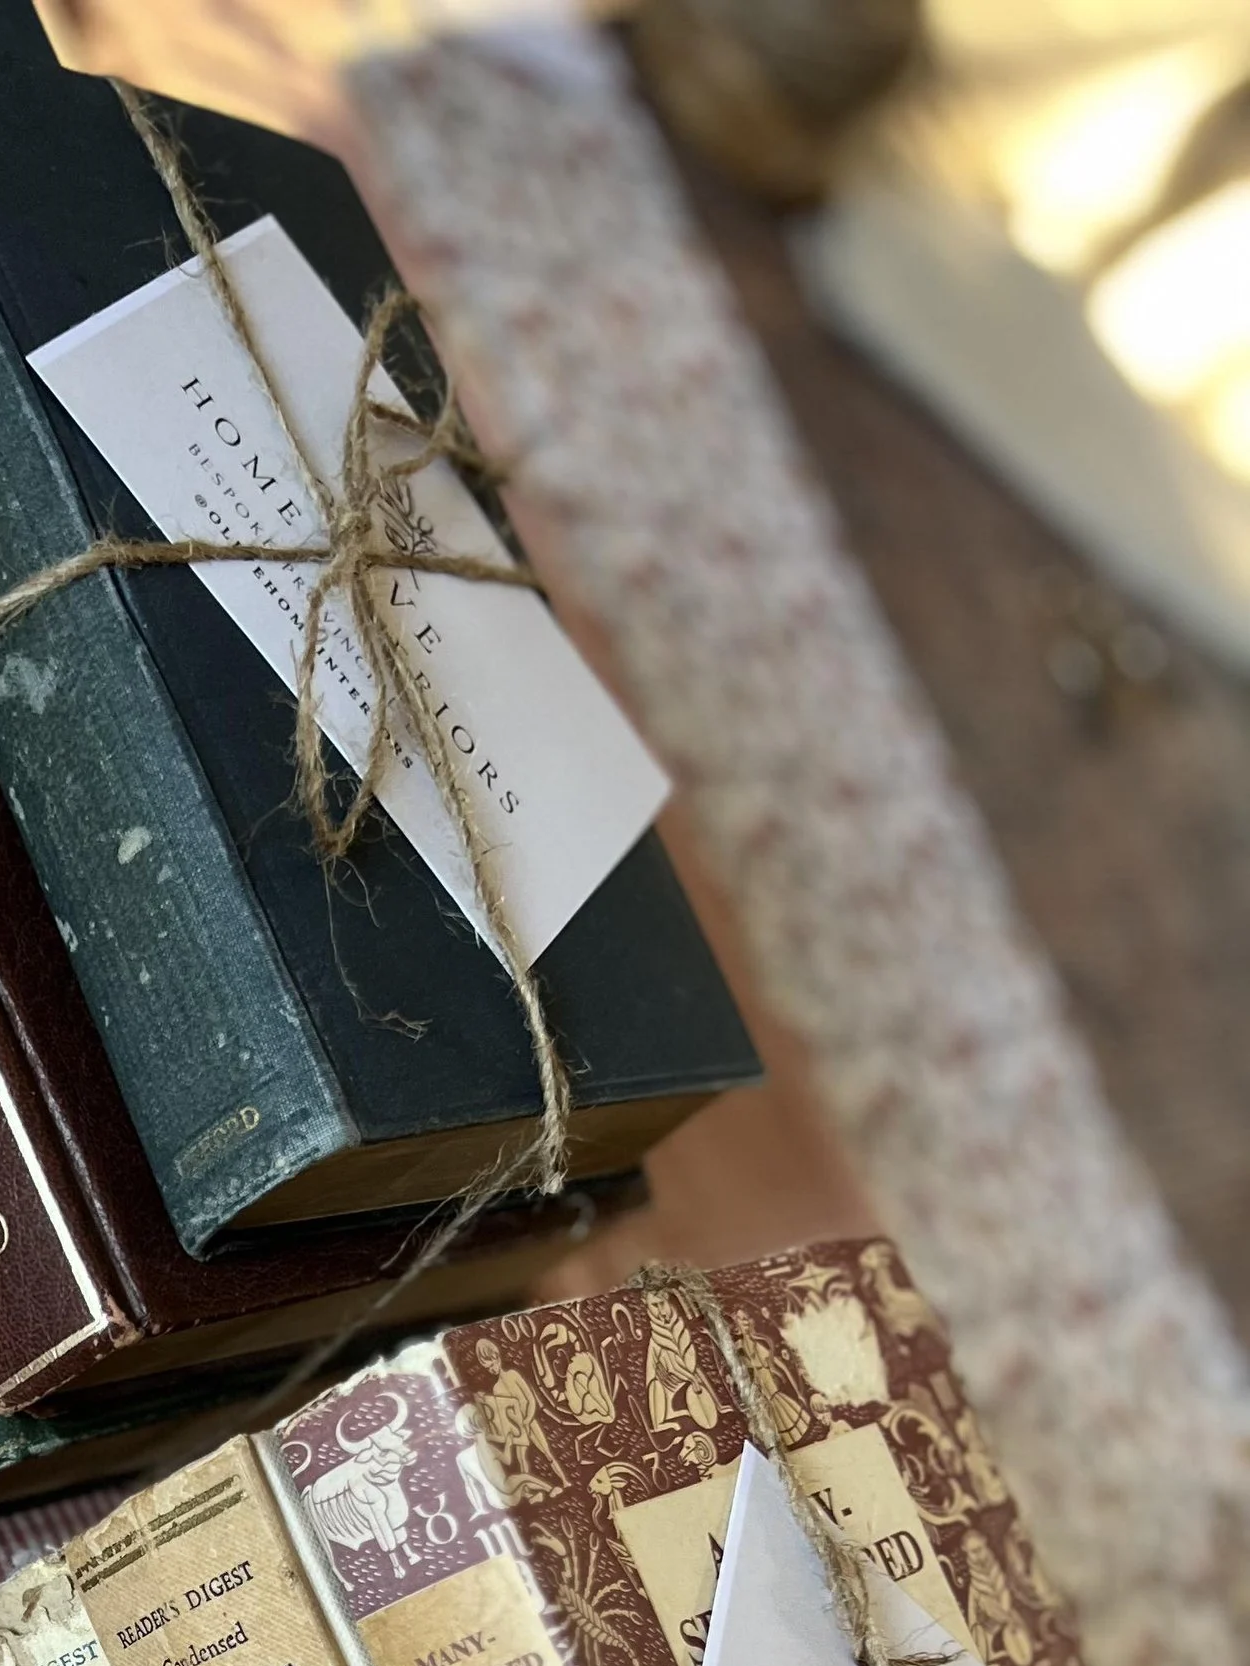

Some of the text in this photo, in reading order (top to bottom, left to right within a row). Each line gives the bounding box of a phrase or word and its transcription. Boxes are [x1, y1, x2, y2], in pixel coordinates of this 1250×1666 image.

[180, 376, 301, 526] HOME
[116, 1560, 254, 1650] READER'S DIGEST
